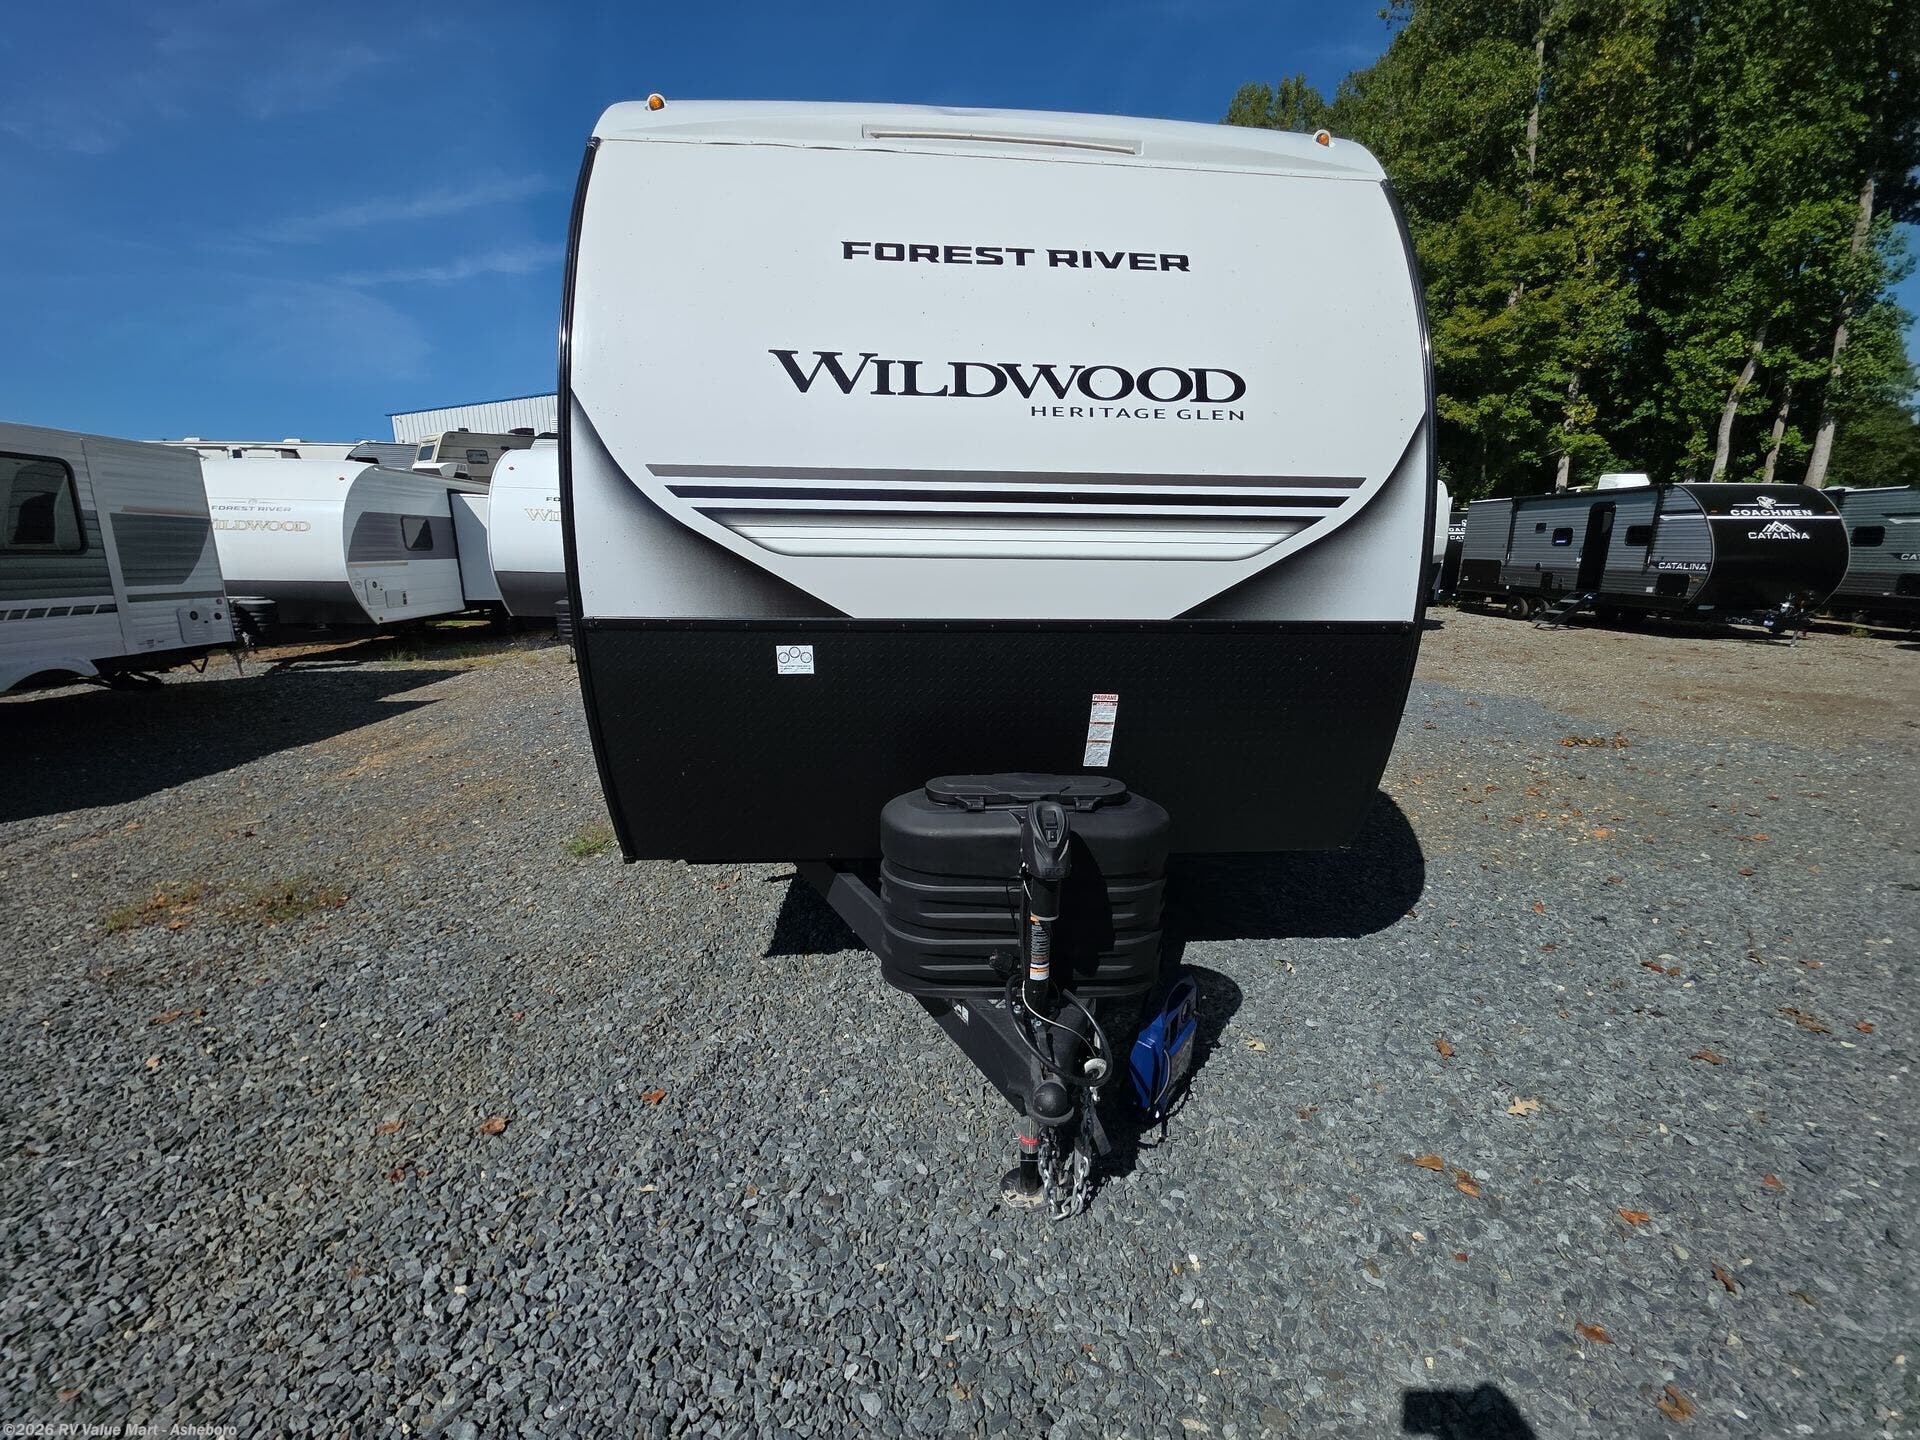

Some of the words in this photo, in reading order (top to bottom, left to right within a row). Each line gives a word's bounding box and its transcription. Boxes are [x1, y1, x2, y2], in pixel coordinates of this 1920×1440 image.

[841, 241, 1034, 266] FOREST
[1047, 249, 1191, 272] RIVER
[768, 349, 1247, 404] WILDWOOD
[1031, 406, 1166, 420] HERITAGE
[1176, 409, 1246, 421] GLEN
[213, 519, 311, 531] ILDWOOD
[1747, 531, 1810, 540] CATALINA
[1658, 562, 1707, 570] CATALINA
